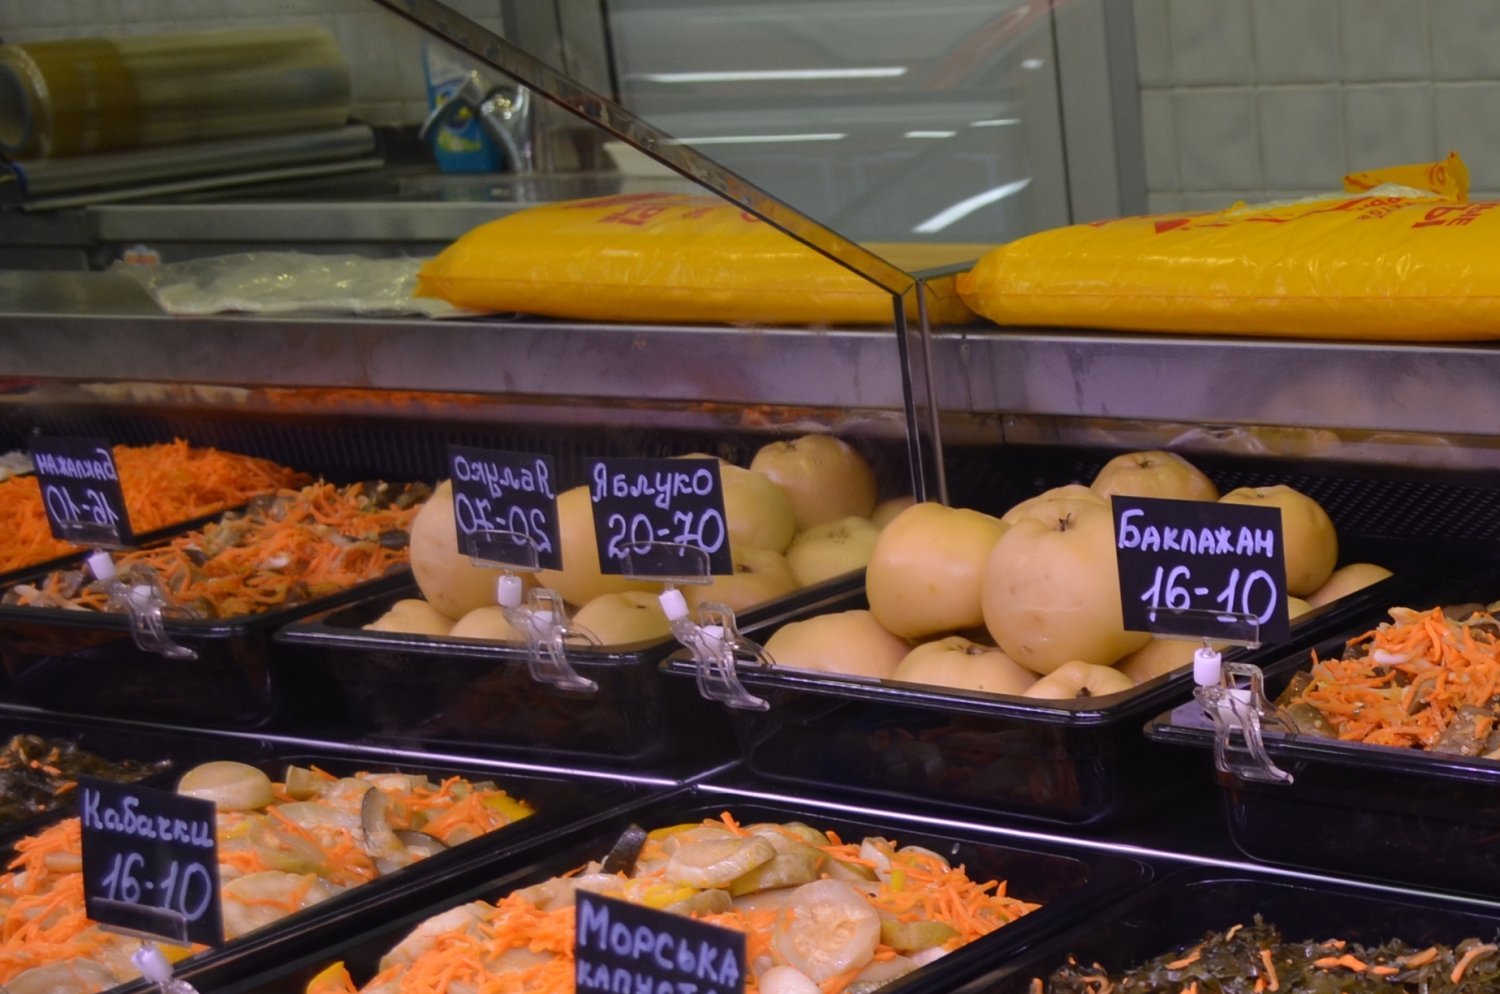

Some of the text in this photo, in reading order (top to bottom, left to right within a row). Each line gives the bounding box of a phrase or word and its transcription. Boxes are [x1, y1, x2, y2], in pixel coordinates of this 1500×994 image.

[592, 462, 713, 510] Яблуко
[608, 508, 725, 558] 20-70
[1140, 565, 1277, 626] 16-10
[84, 788, 214, 848] Кабачки
[102, 852, 212, 921] 16-10
